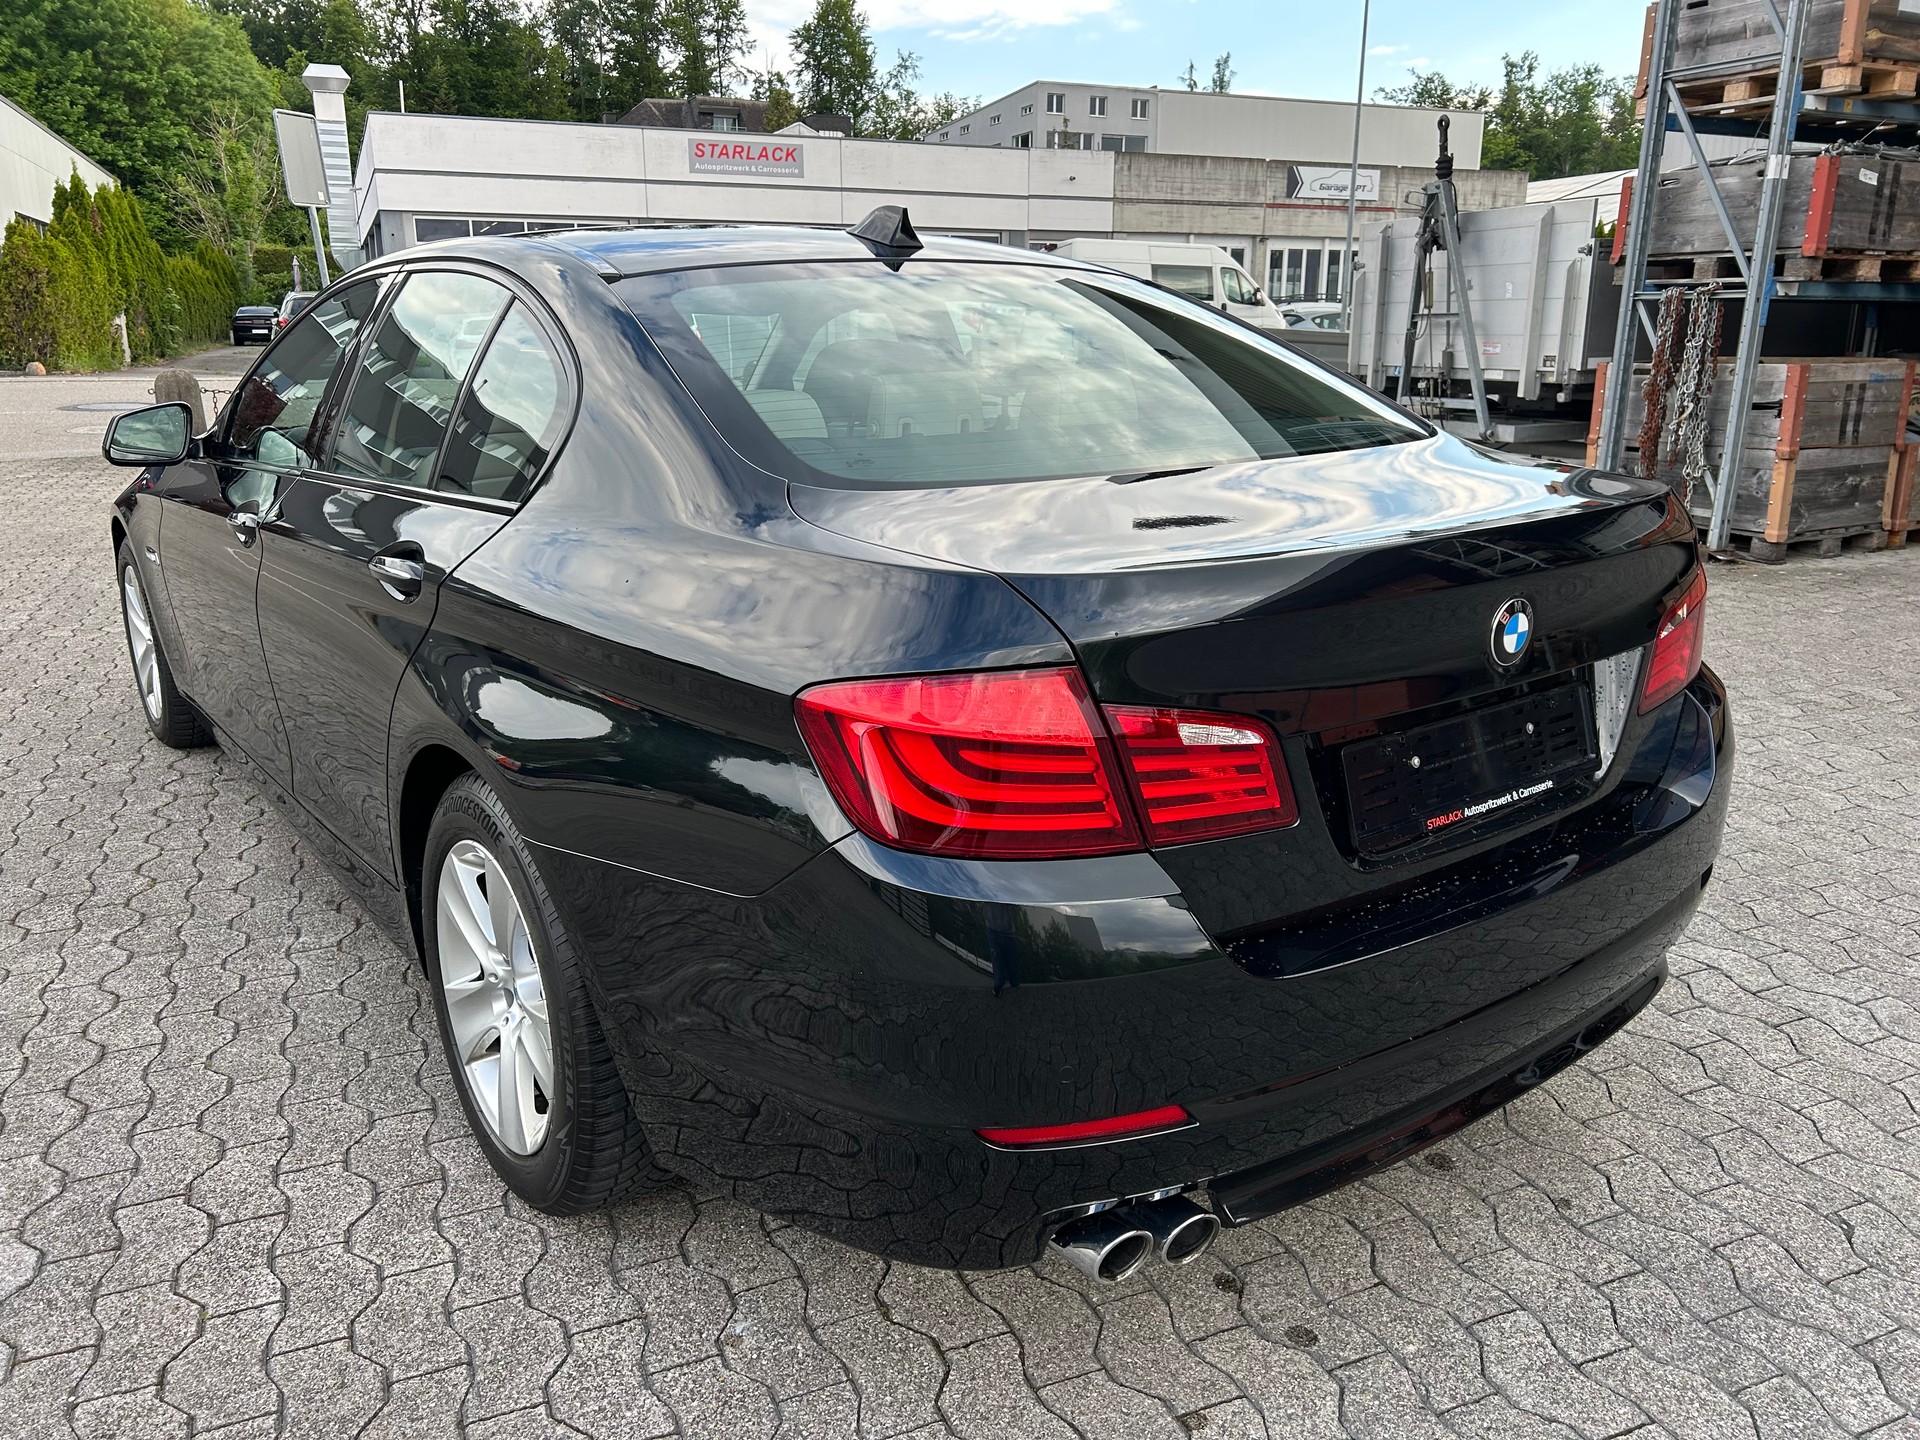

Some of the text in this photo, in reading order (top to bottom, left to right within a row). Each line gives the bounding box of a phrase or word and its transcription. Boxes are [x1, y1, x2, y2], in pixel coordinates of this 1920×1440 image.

[694, 142, 797, 163] STARLACK
[694, 162, 750, 172] Autospritzwerk
[757, 165, 799, 174] Carrosserie
[1319, 183, 1349, 193] Garage
[1500, 600, 1532, 625] BMW
[1426, 779, 1554, 830] STARLACK Autospritzwerk & Carrosserie
